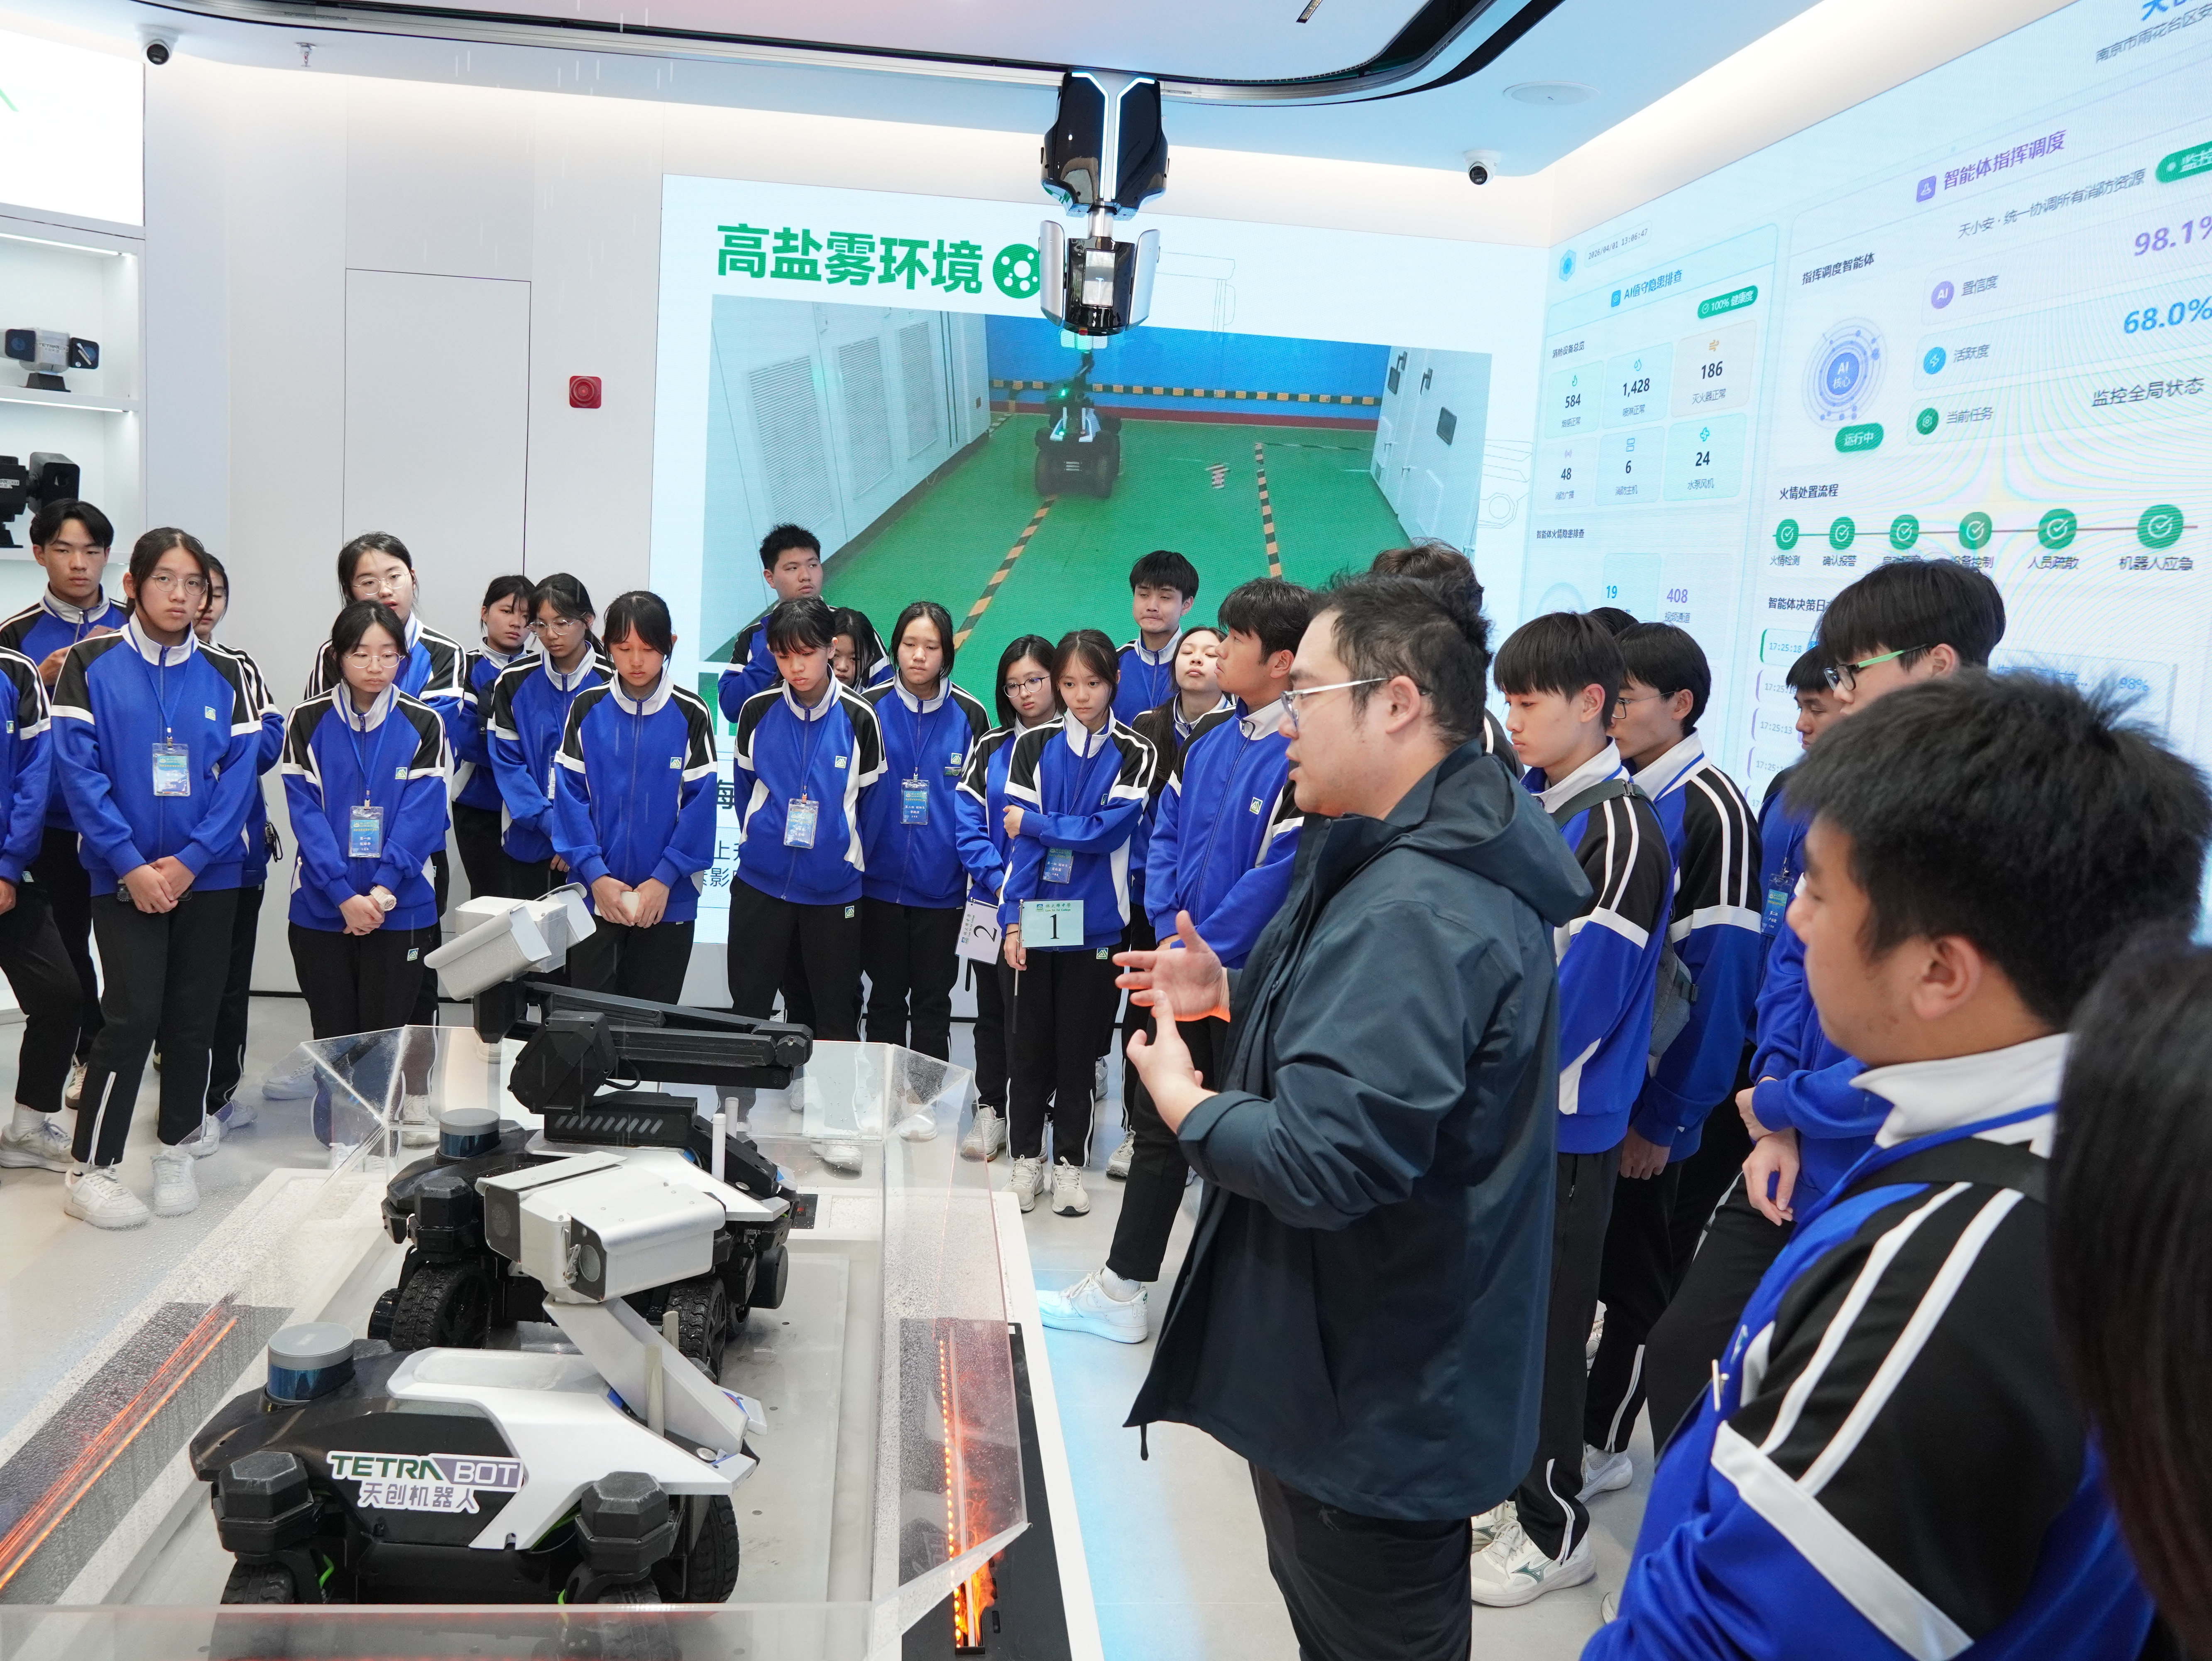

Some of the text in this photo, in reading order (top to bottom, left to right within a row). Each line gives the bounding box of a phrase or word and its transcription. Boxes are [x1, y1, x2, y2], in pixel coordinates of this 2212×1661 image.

[1944, 130, 2066, 191] 智能体指挥调度
[1588, 228, 1648, 260] 2026/04/01 13:06:47
[717, 223, 983, 294] 高盐雾环境
[1802, 252, 1875, 285] 指挥调度智能体
[1624, 269, 1682, 300] AI值守隐患排查
[1961, 275, 1998, 296] 置信度
[1711, 298, 1730, 311] 100%
[2124, 296, 2212, 334] 68.0%
[1552, 341, 1585, 359] 消防设备总览
[1953, 344, 1990, 363] 活跃度
[1701, 361, 1723, 379] 186
[1838, 361, 1849, 375] AI
[1622, 377, 1650, 397] 1,428
[1833, 376, 1851, 390] 核心
[1691, 388, 1726, 404] 灭火器正常
[2091, 377, 2205, 407] 监控全局状态
[1565, 393, 1581, 408] 584
[1946, 406, 1994, 425] 当前任务
[1843, 431, 1874, 447] 运行中
[1696, 451, 1710, 466] 24
[1561, 468, 1571, 480] 48
[1626, 460, 1631, 473] 6
[1615, 485, 1638, 495] 消防主机
[1687, 478, 1714, 490] 水泵风机
[1779, 483, 1839, 500] 火情处置流程
[1537, 529, 1585, 539] 智能体火情隐患排查
[1770, 554, 1800, 566] 火情检测
[1823, 555, 1857, 567] 确认报警
[2028, 555, 2079, 570] 人员疏散
[2119, 556, 2194, 571] 机器人应急
[1606, 586, 1617, 599] 19
[1667, 588, 1688, 603] 408
[1769, 597, 1831, 612] 智能体决策日
[1769, 642, 1802, 653] 17:25:18
[2119, 677, 2150, 691] 98%
[1760, 721, 1792, 734] 17:25:13
[974, 925, 997, 942] 2
[1050, 914, 1060, 939] 1
[331, 1455, 518, 1485] TETRA BOT
[362, 1482, 475, 1509] 天创机器人
